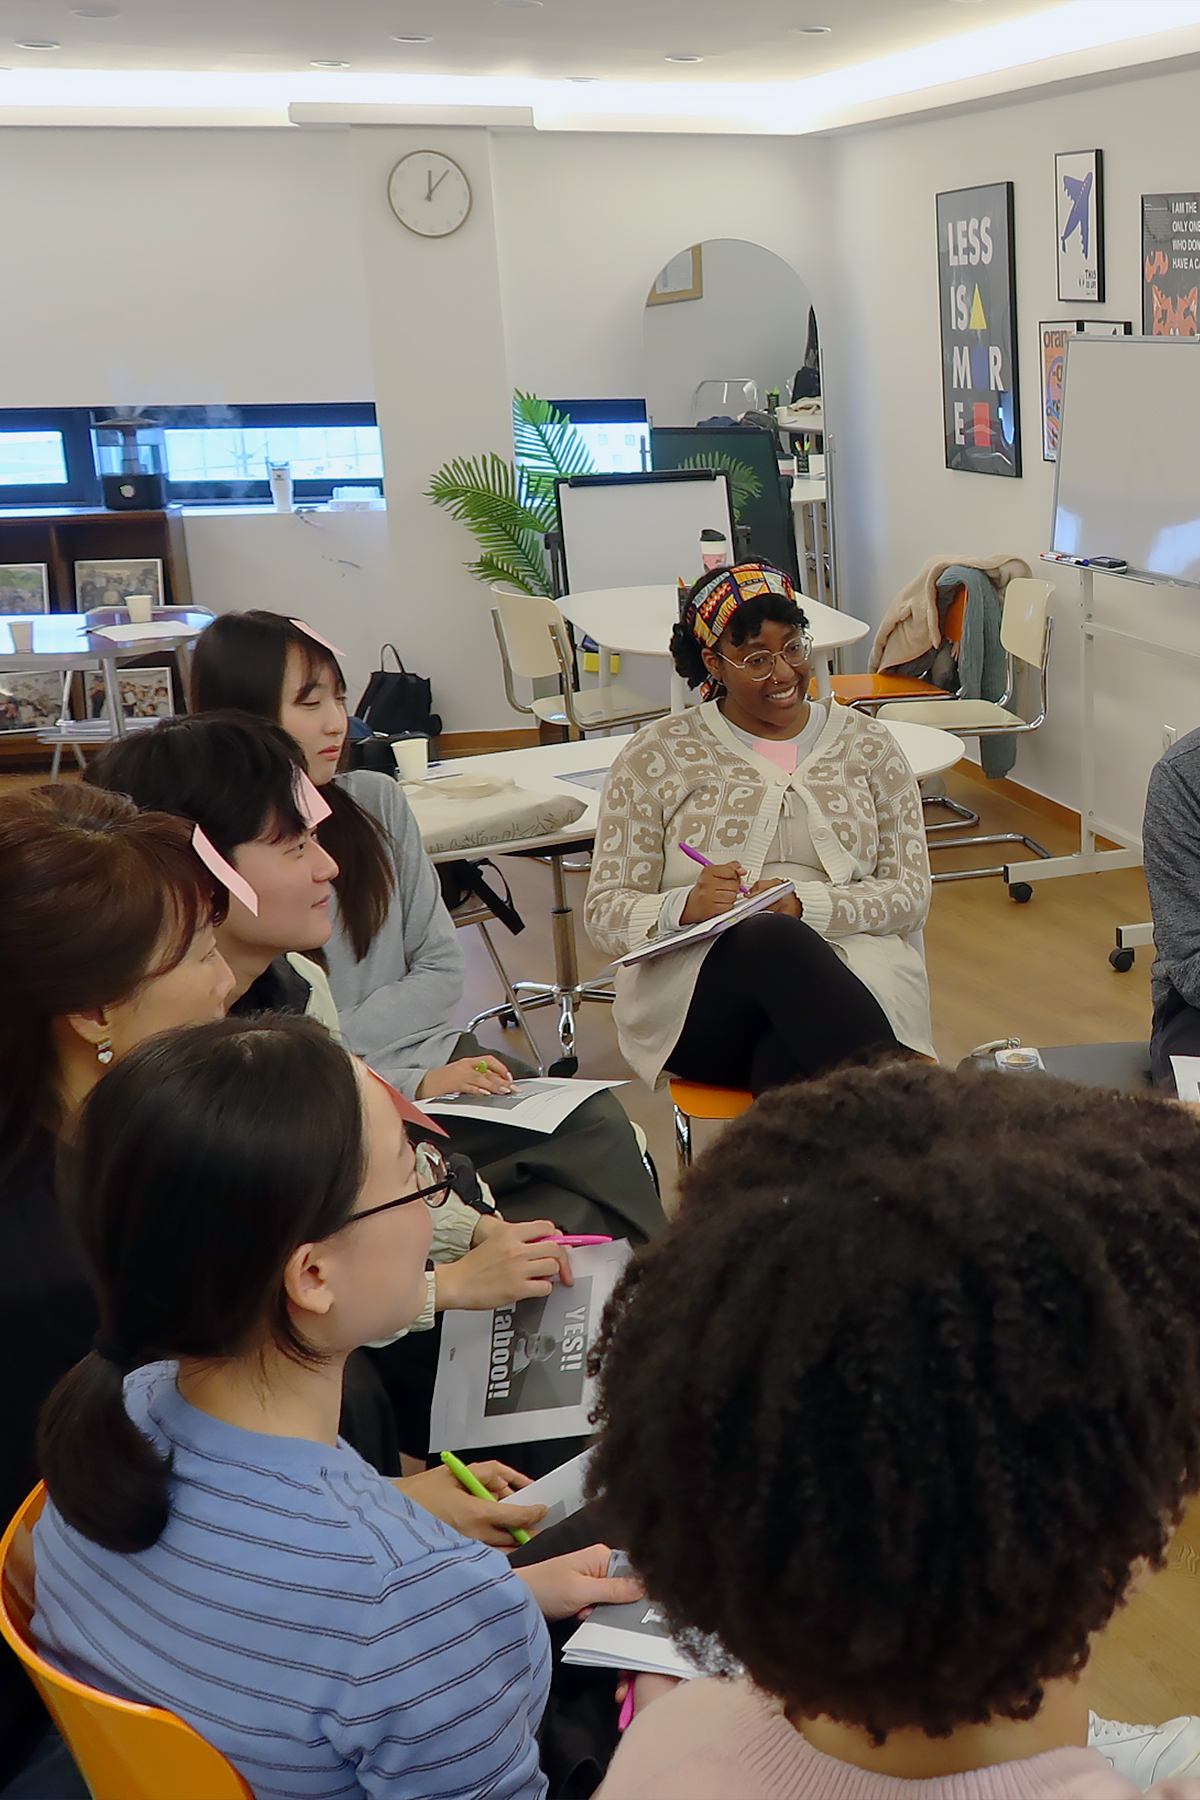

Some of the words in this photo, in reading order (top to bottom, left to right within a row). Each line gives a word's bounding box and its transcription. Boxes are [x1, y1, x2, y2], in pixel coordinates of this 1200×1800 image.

[1175, 202, 1185, 214] AM
[1185, 201, 1198, 213] THE
[947, 216, 993, 267] LESS
[1172, 220, 1188, 233] ONLY
[1172, 239, 1187, 251] WHO
[1172, 257, 1188, 269] HAVE
[1188, 257, 1194, 269] A
[950, 284, 969, 331] IS
[488, 1300, 517, 1400] Taboo!!
[560, 1304, 587, 1372] YES!!
